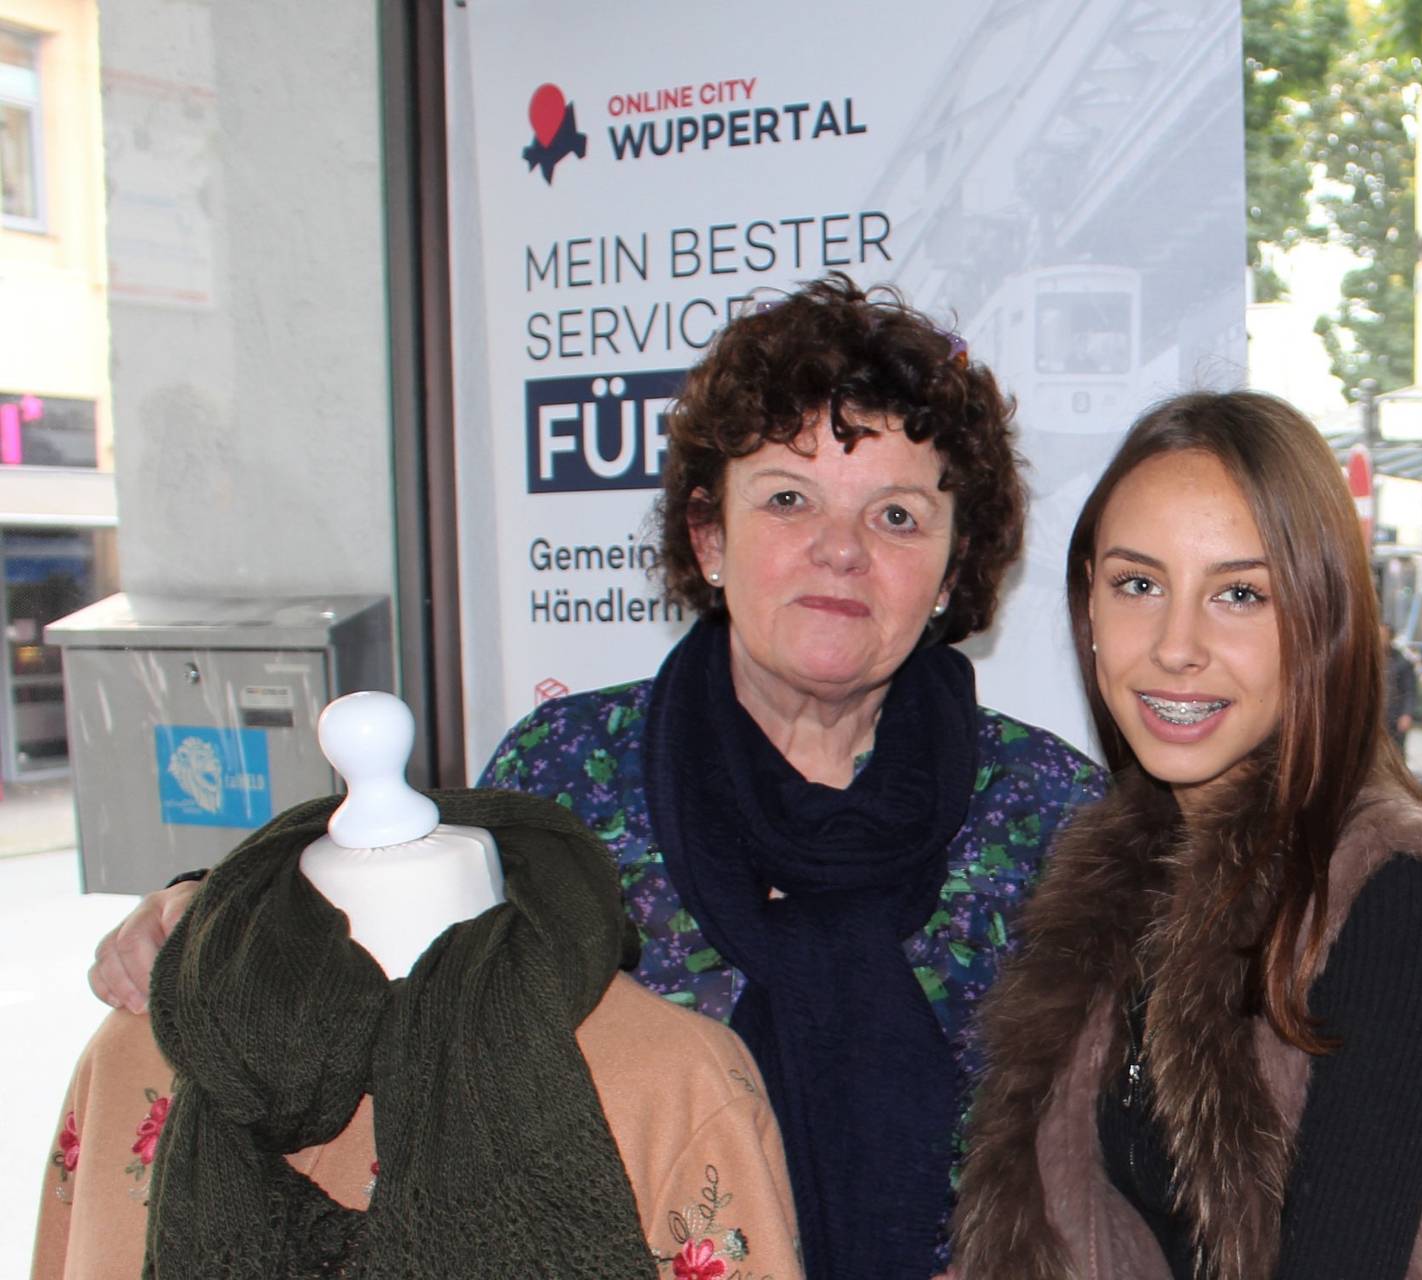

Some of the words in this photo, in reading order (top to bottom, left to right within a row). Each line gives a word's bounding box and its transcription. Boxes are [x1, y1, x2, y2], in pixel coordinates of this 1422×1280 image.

[607, 86, 693, 117] ONLINE
[699, 77, 757, 105] CITY
[607, 98, 868, 161] WUPPERTAL
[525, 232, 648, 292] MEIN
[670, 210, 892, 279] BESTER
[530, 587, 684, 623] Händlern
